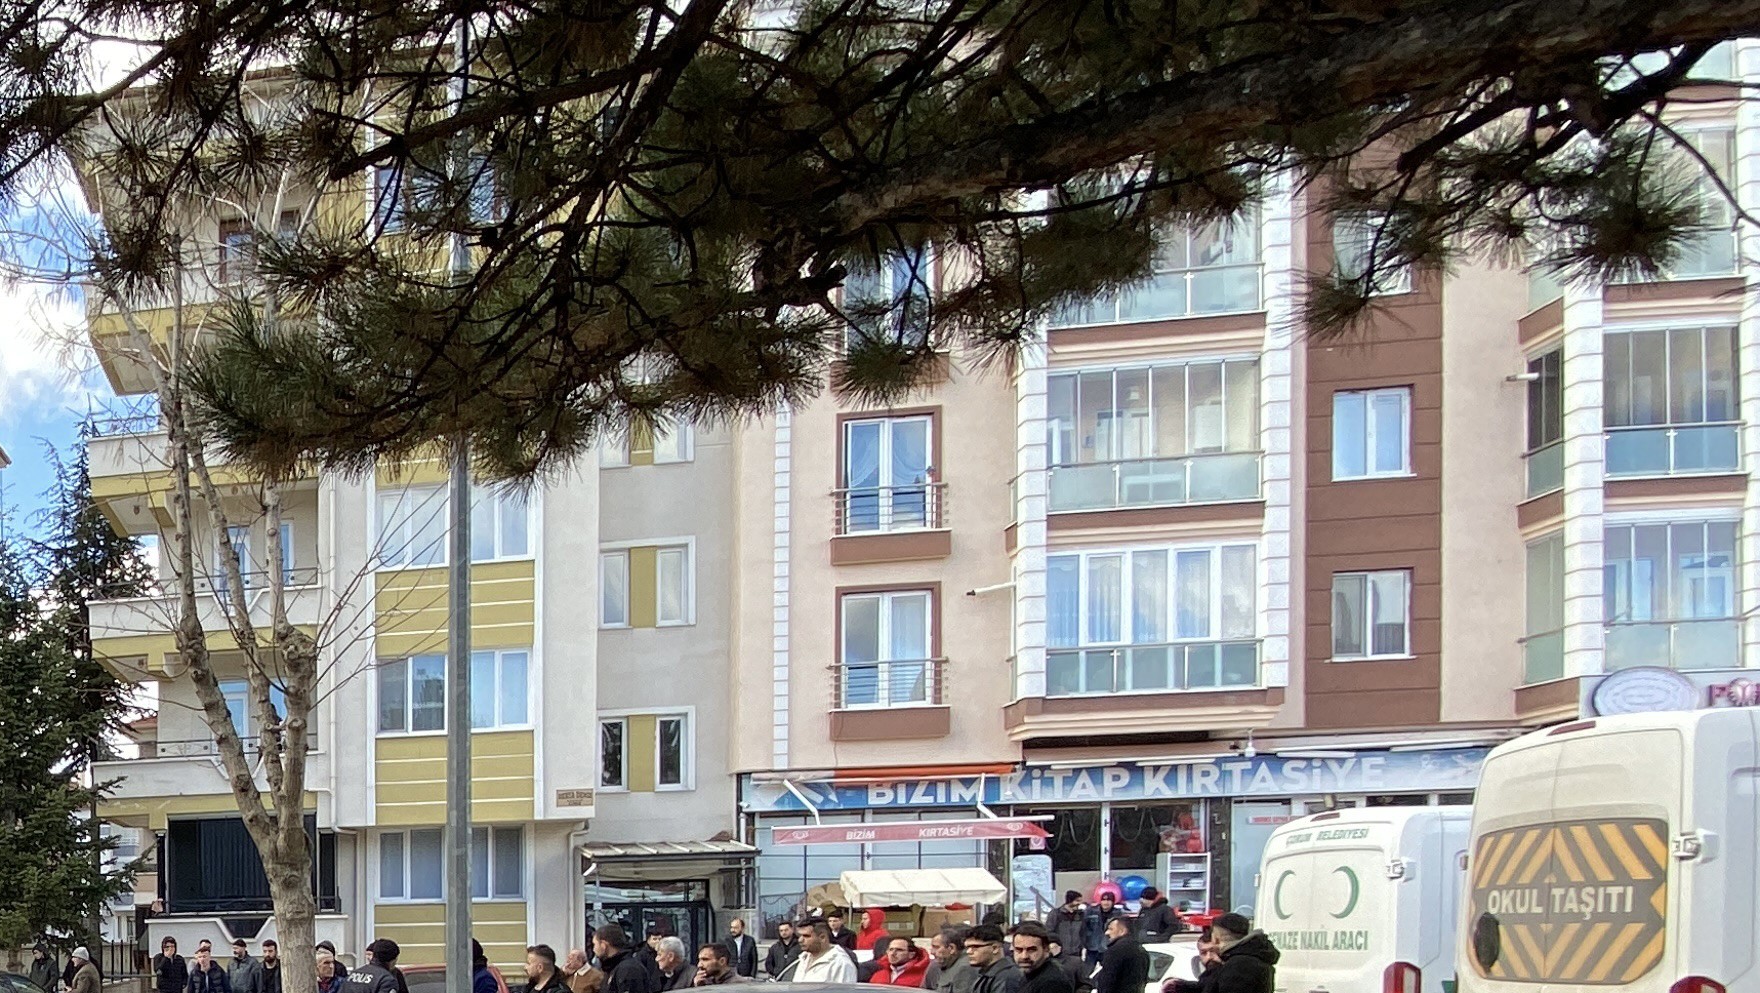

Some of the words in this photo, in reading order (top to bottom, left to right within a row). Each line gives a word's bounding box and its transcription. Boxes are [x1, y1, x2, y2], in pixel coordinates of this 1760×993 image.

[1487, 888, 1544, 915] OKUL
[1550, 885, 1634, 921] TAŞITI
[1332, 930, 1369, 950] ARACI
